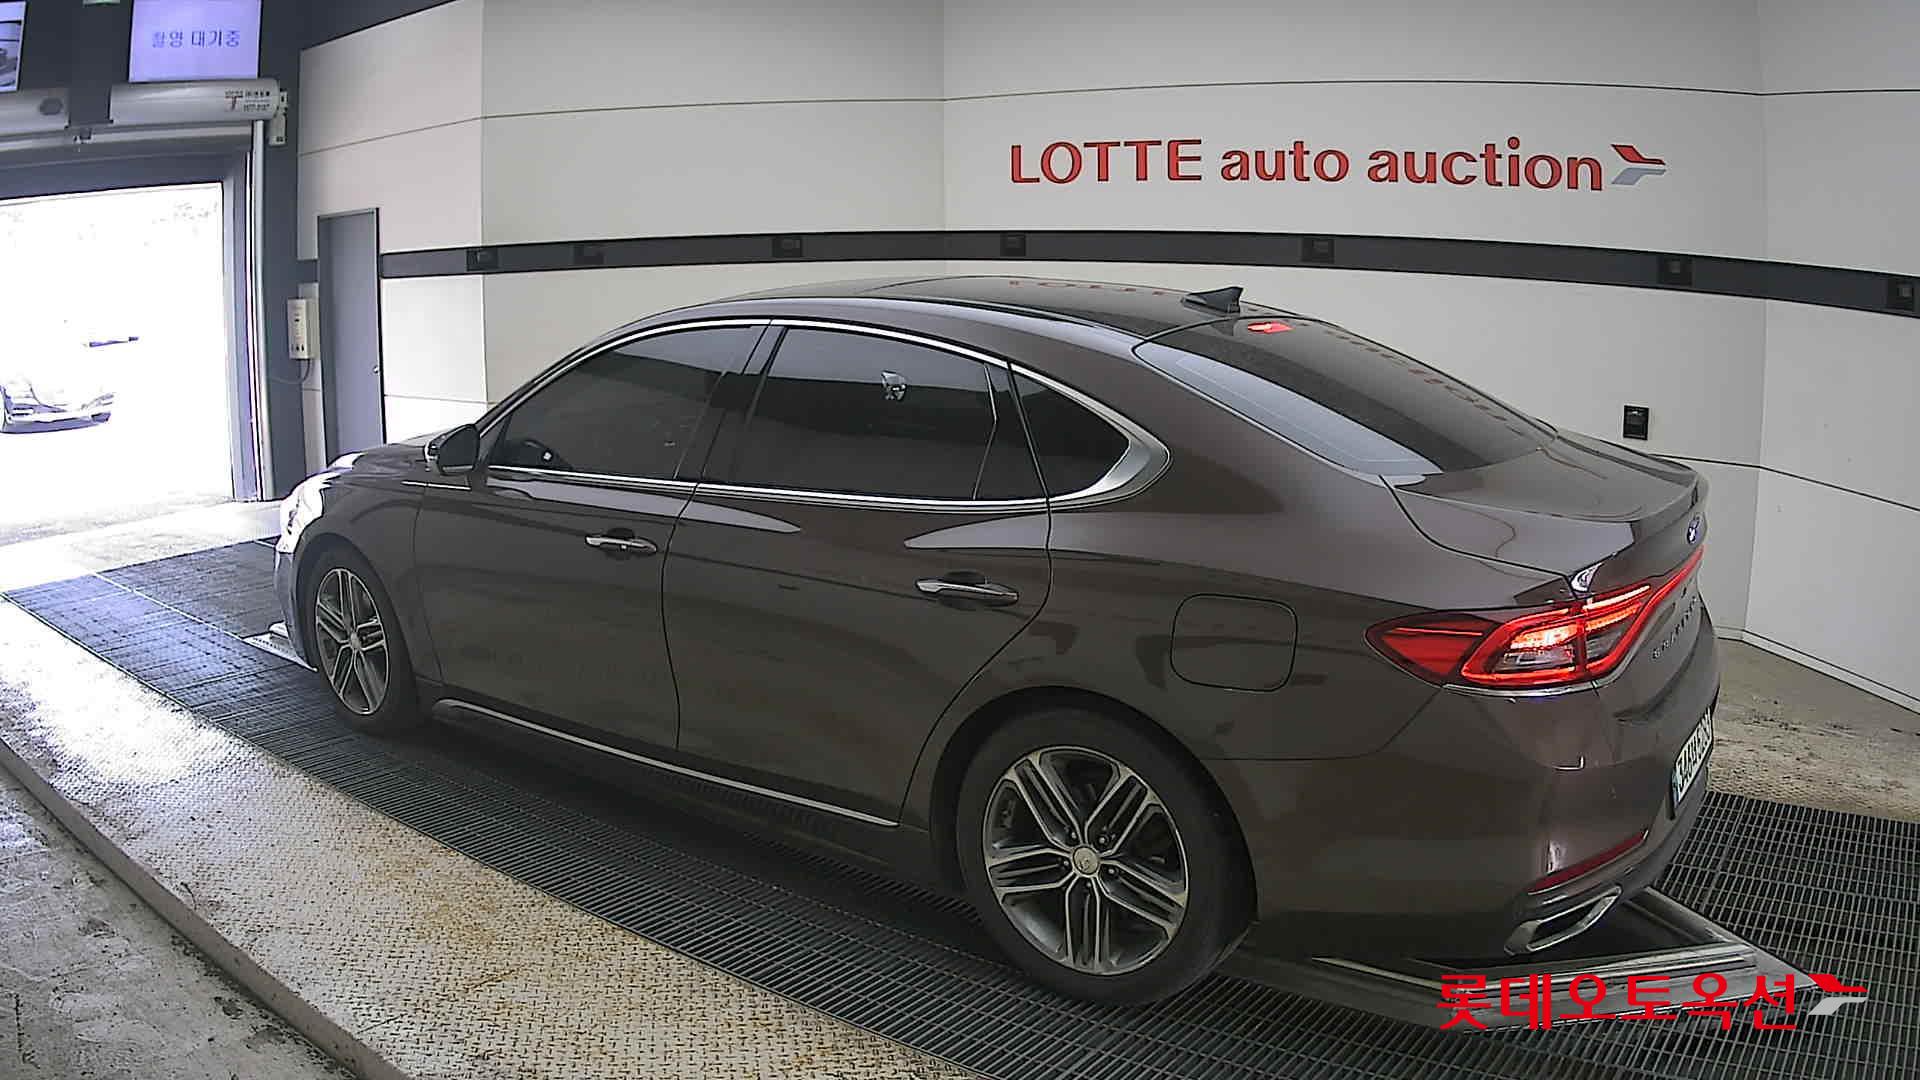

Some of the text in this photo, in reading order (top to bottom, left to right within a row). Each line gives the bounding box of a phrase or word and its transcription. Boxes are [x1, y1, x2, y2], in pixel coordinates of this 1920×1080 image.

[1010, 136, 1604, 191] LOTTE auto auction
